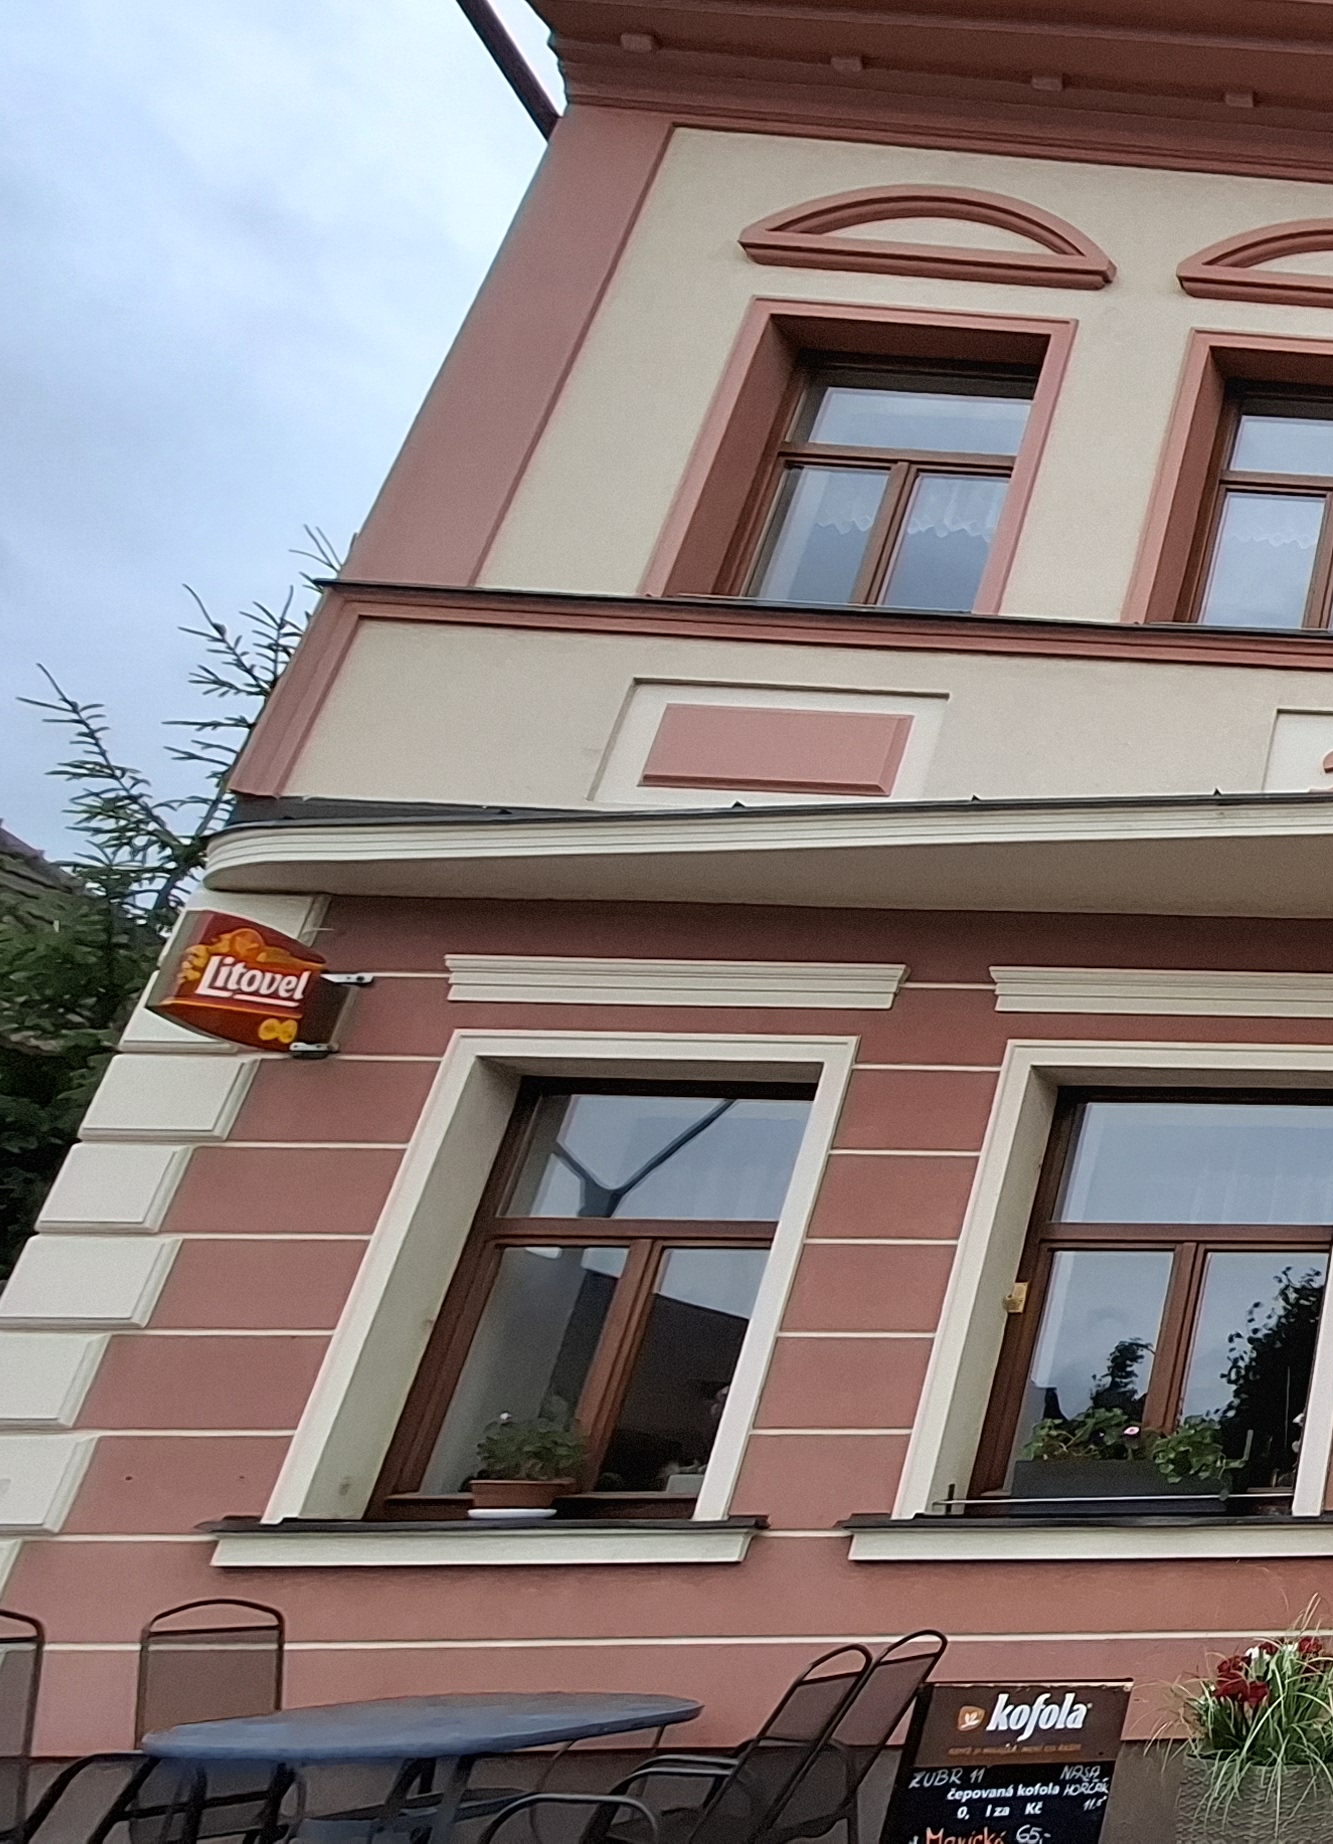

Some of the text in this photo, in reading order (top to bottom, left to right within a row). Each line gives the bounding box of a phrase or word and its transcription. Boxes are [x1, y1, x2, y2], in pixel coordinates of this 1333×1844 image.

[195, 955, 311, 1001] Litovel
[986, 1692, 1088, 1742] kofola
[908, 1766, 985, 1789] ZUBR 11
[946, 1781, 1060, 1803] čepovaná kofola
[993, 1806, 1010, 1817] za
[1024, 1801, 1043, 1815] Kč
